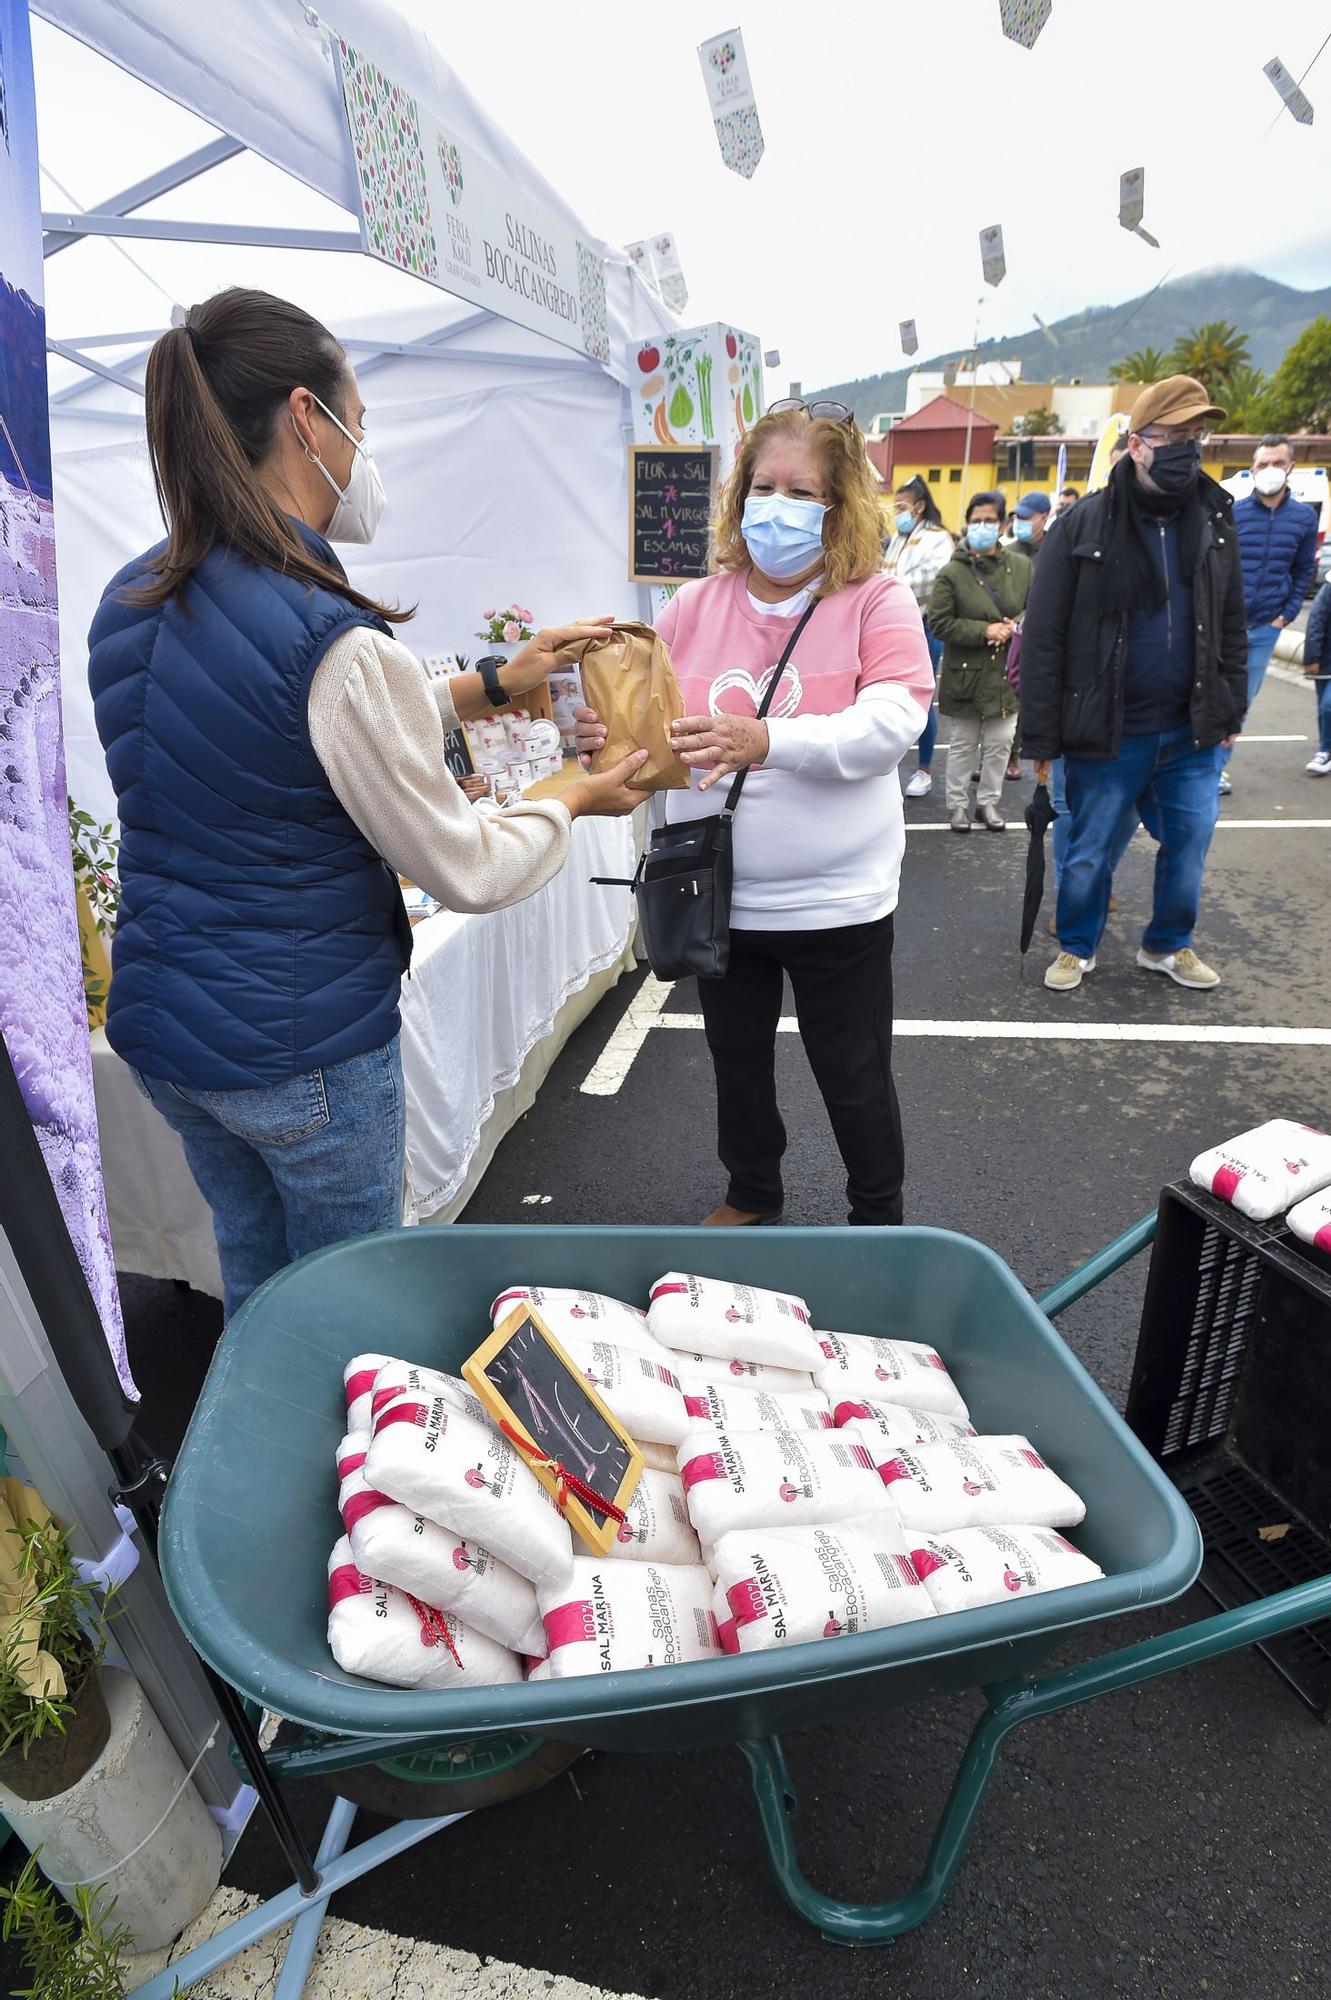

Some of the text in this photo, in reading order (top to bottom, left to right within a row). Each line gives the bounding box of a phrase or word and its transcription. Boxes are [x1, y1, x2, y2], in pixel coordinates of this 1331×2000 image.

[446, 213, 471, 247] FERIA
[505, 213, 557, 277] SALINAS
[483, 240, 578, 324] BOCACANGREJO
[637, 461, 667, 480] FLOR
[682, 462, 709, 481] SAL
[636, 505, 658, 519] SAL
[644, 540, 700, 557] ESCAMAS
[424, 1396, 445, 1452] SAL MARINA
[706, 1386, 725, 1430] AL MARINA
[878, 1420, 890, 1436] SAL
[718, 1435, 745, 1494] SAL MARINA
[775, 1436, 796, 1466] Salinas
[916, 1476, 932, 1492] SAL
[414, 1516, 426, 1535] SA
[814, 1546, 843, 1593] Salinas
[814, 1530, 858, 1616] Bocacangrejo
[954, 1560, 972, 1582] SAL
[376, 1592, 388, 1618] SAL
[646, 1586, 664, 1640] Salinas
[648, 1568, 676, 1664] Bocacangrejo
[746, 1577, 768, 1618] 100%
[750, 1554, 786, 1639] SAL MARINA
[582, 1600, 597, 1642] 100%
[592, 1574, 612, 1671] SAL MARINA
